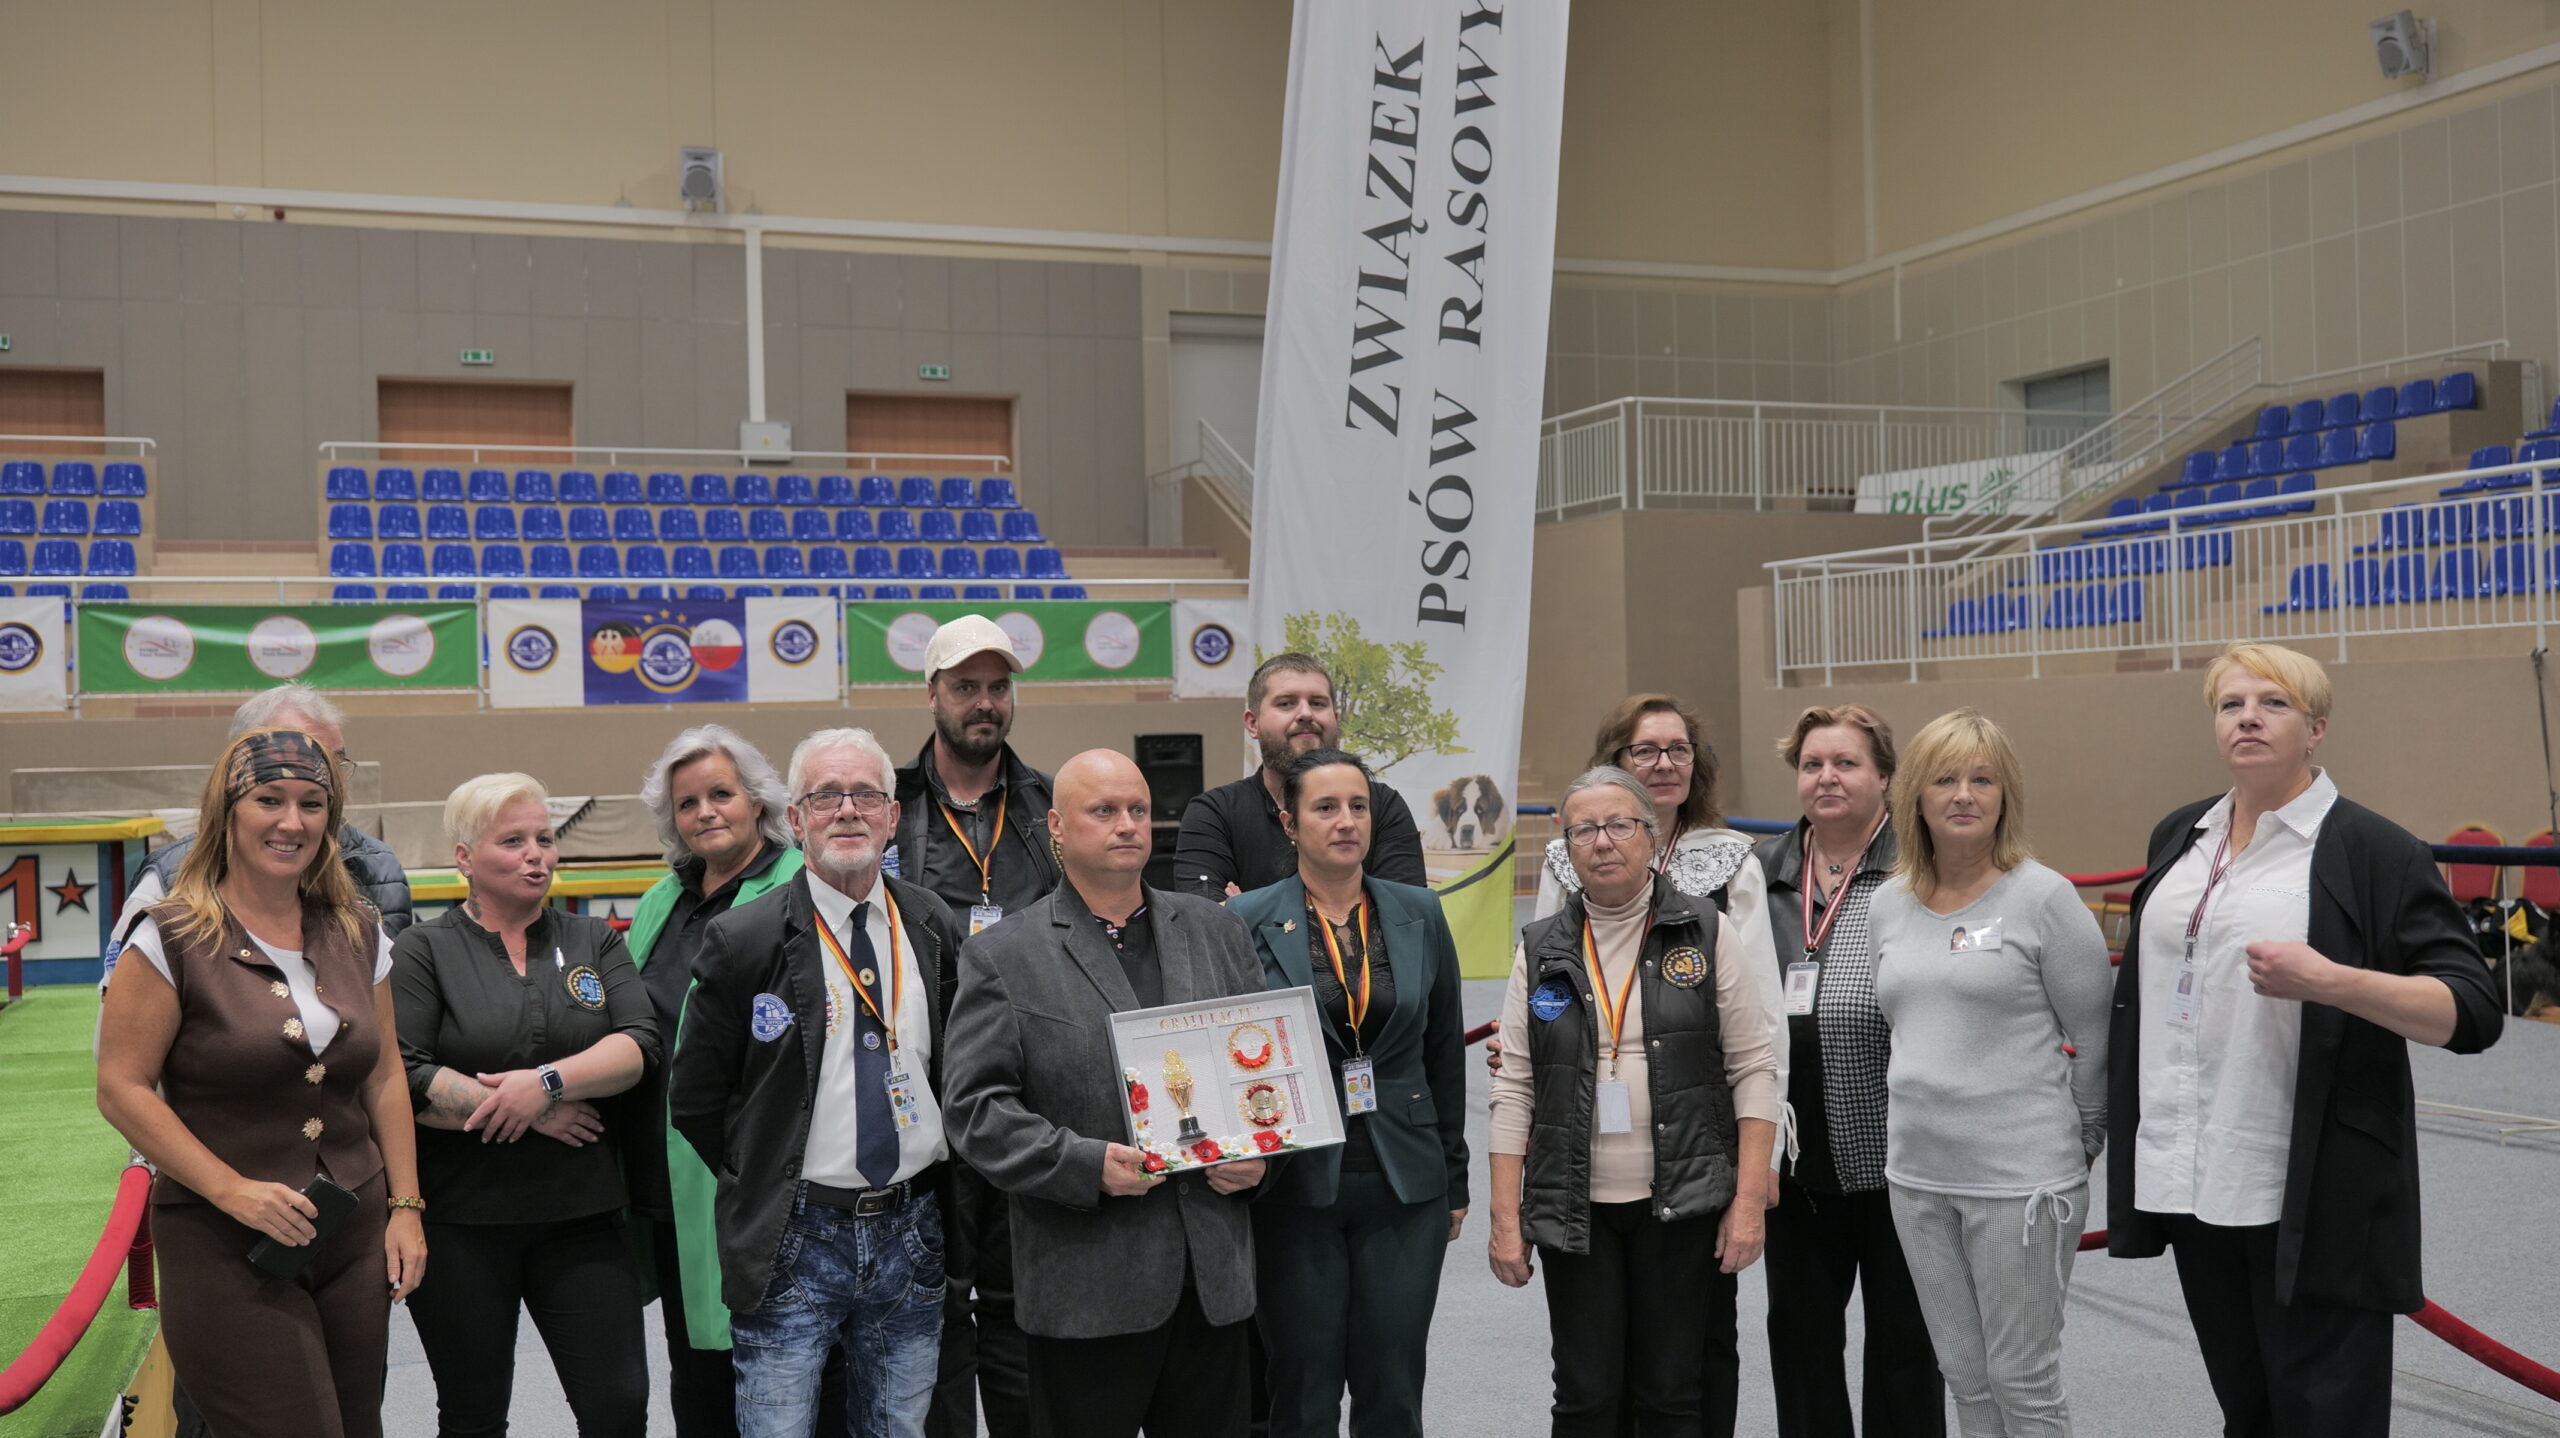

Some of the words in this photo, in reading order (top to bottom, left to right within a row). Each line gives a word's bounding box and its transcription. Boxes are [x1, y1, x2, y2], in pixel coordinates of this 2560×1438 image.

[1345, 31, 1428, 437] ZWIĄZEK
[1409, 388, 1480, 631] PSÓW
[1889, 479, 1968, 513] plus
